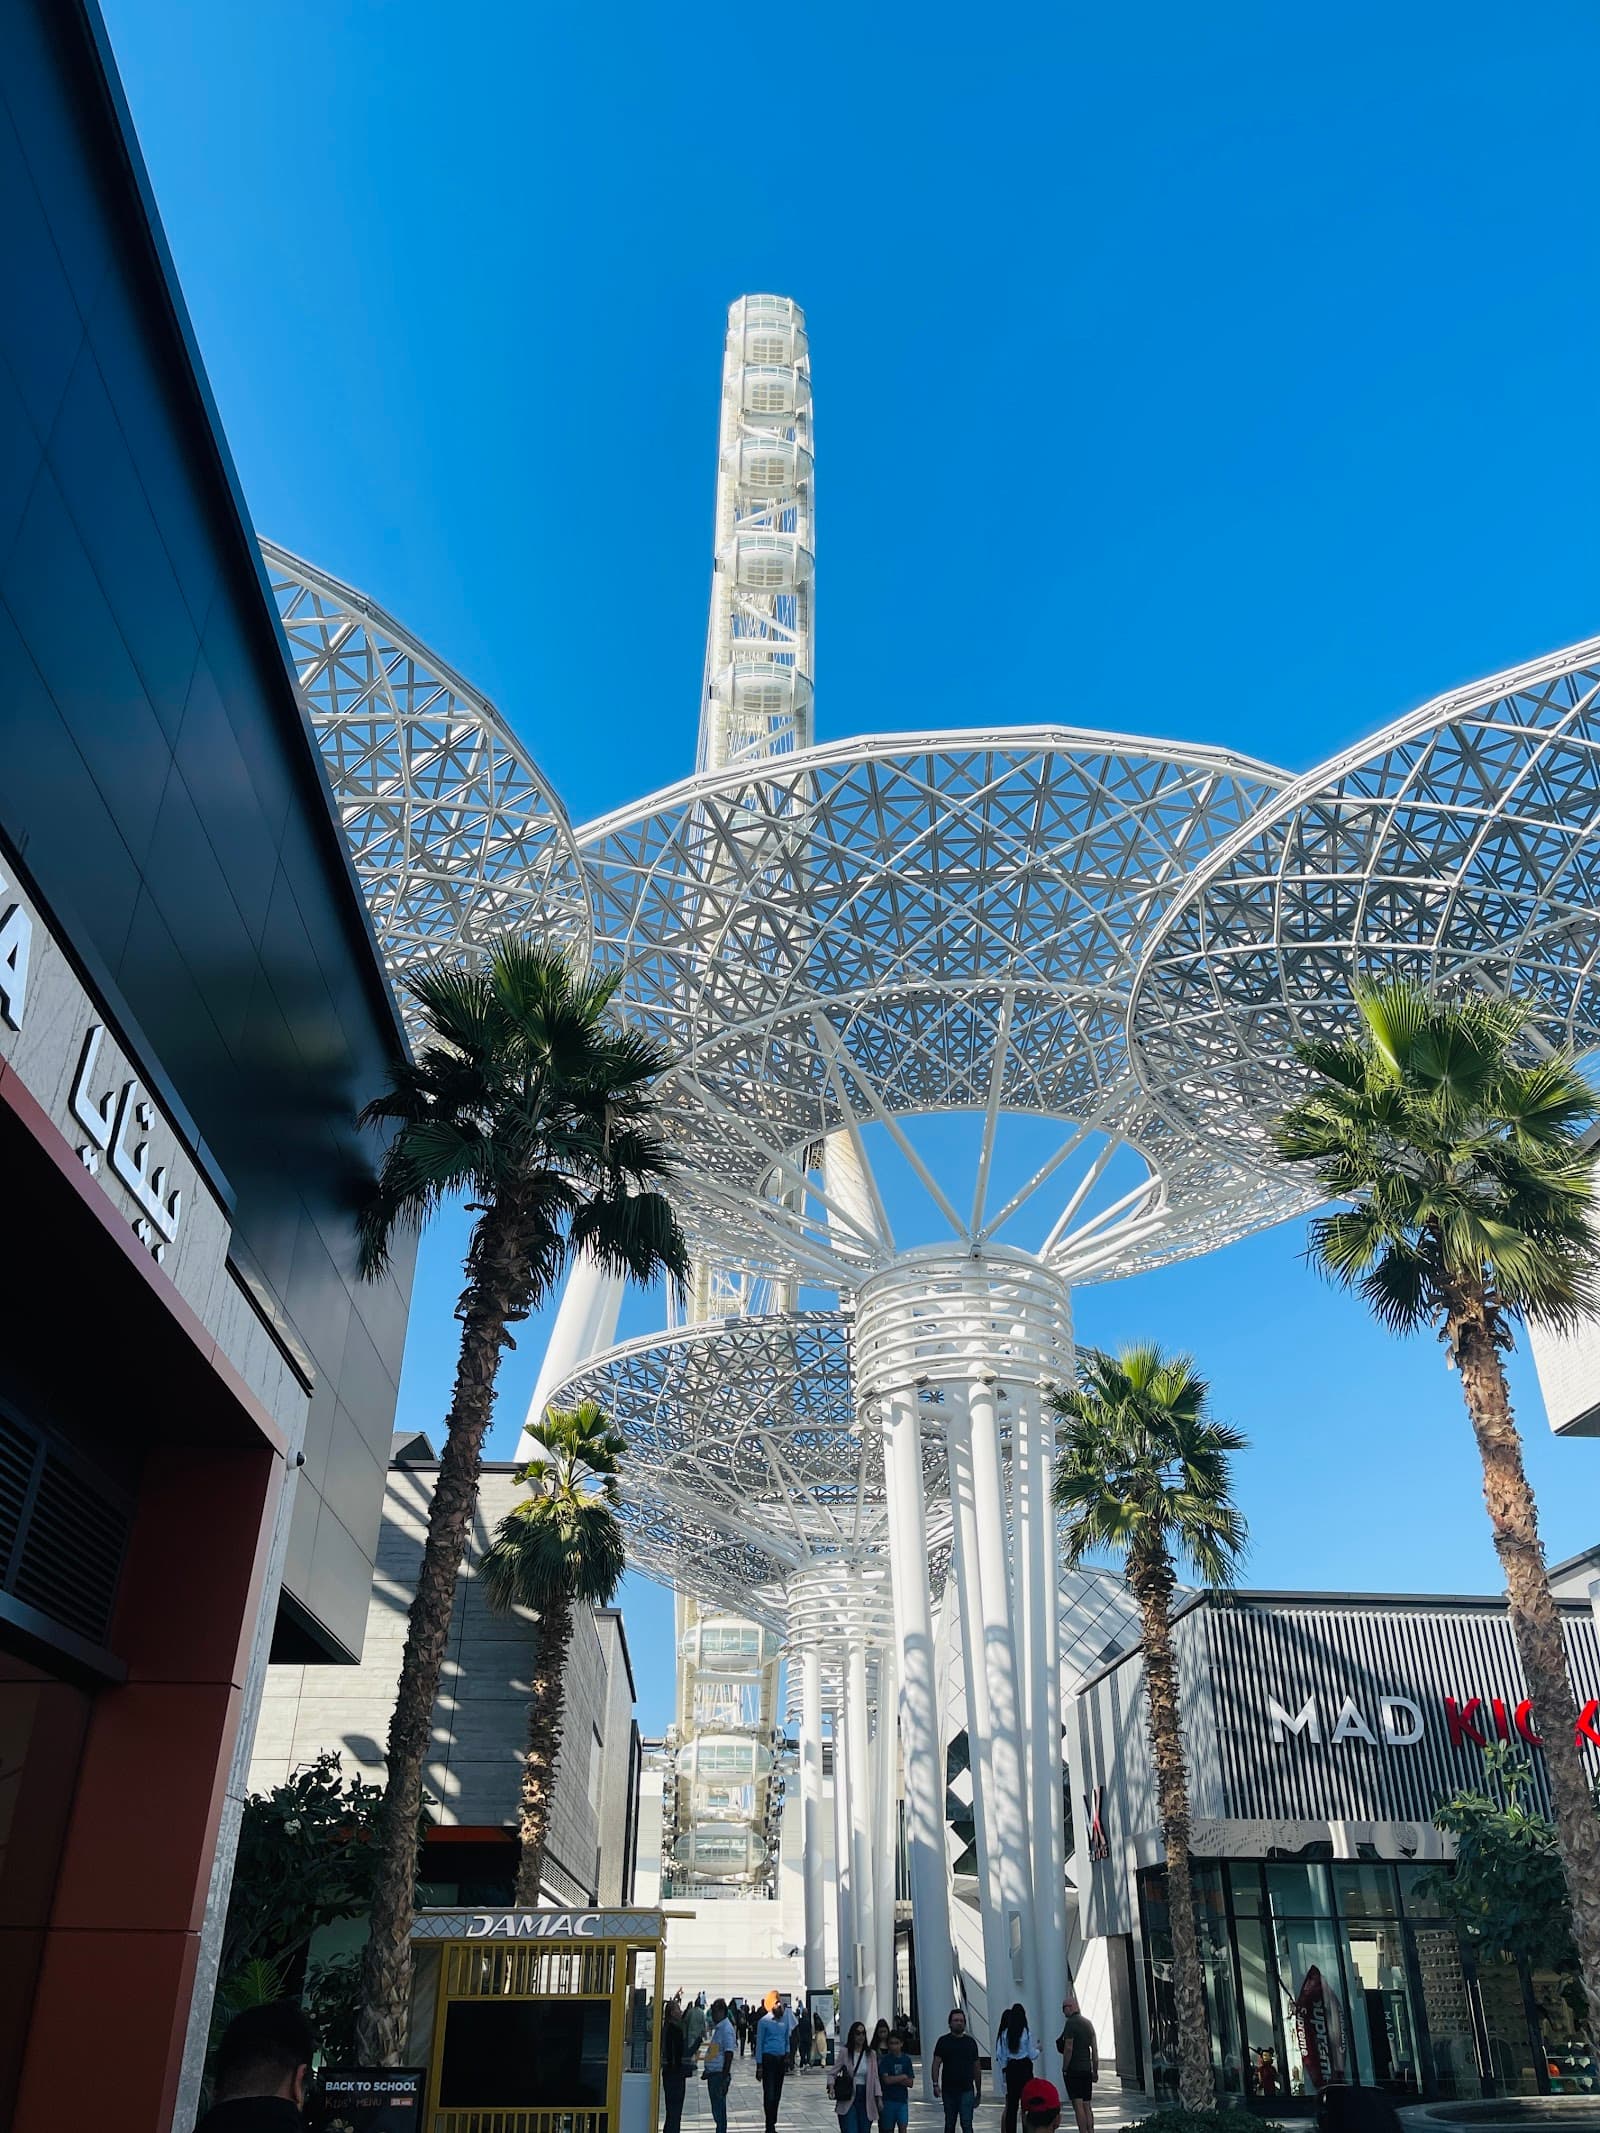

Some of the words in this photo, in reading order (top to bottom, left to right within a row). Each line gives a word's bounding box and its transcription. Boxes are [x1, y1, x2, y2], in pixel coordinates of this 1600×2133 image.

[1269, 1695, 1425, 1746] MAD
[466, 1914, 600, 1937] DAMAC
[1296, 2006, 1309, 2057] Supreme
[1384, 2010, 1396, 2041] MAD
[325, 2081, 355, 2091] BACK
[356, 2081, 372, 2091] TO
[373, 2081, 417, 2091] SCHOOL
